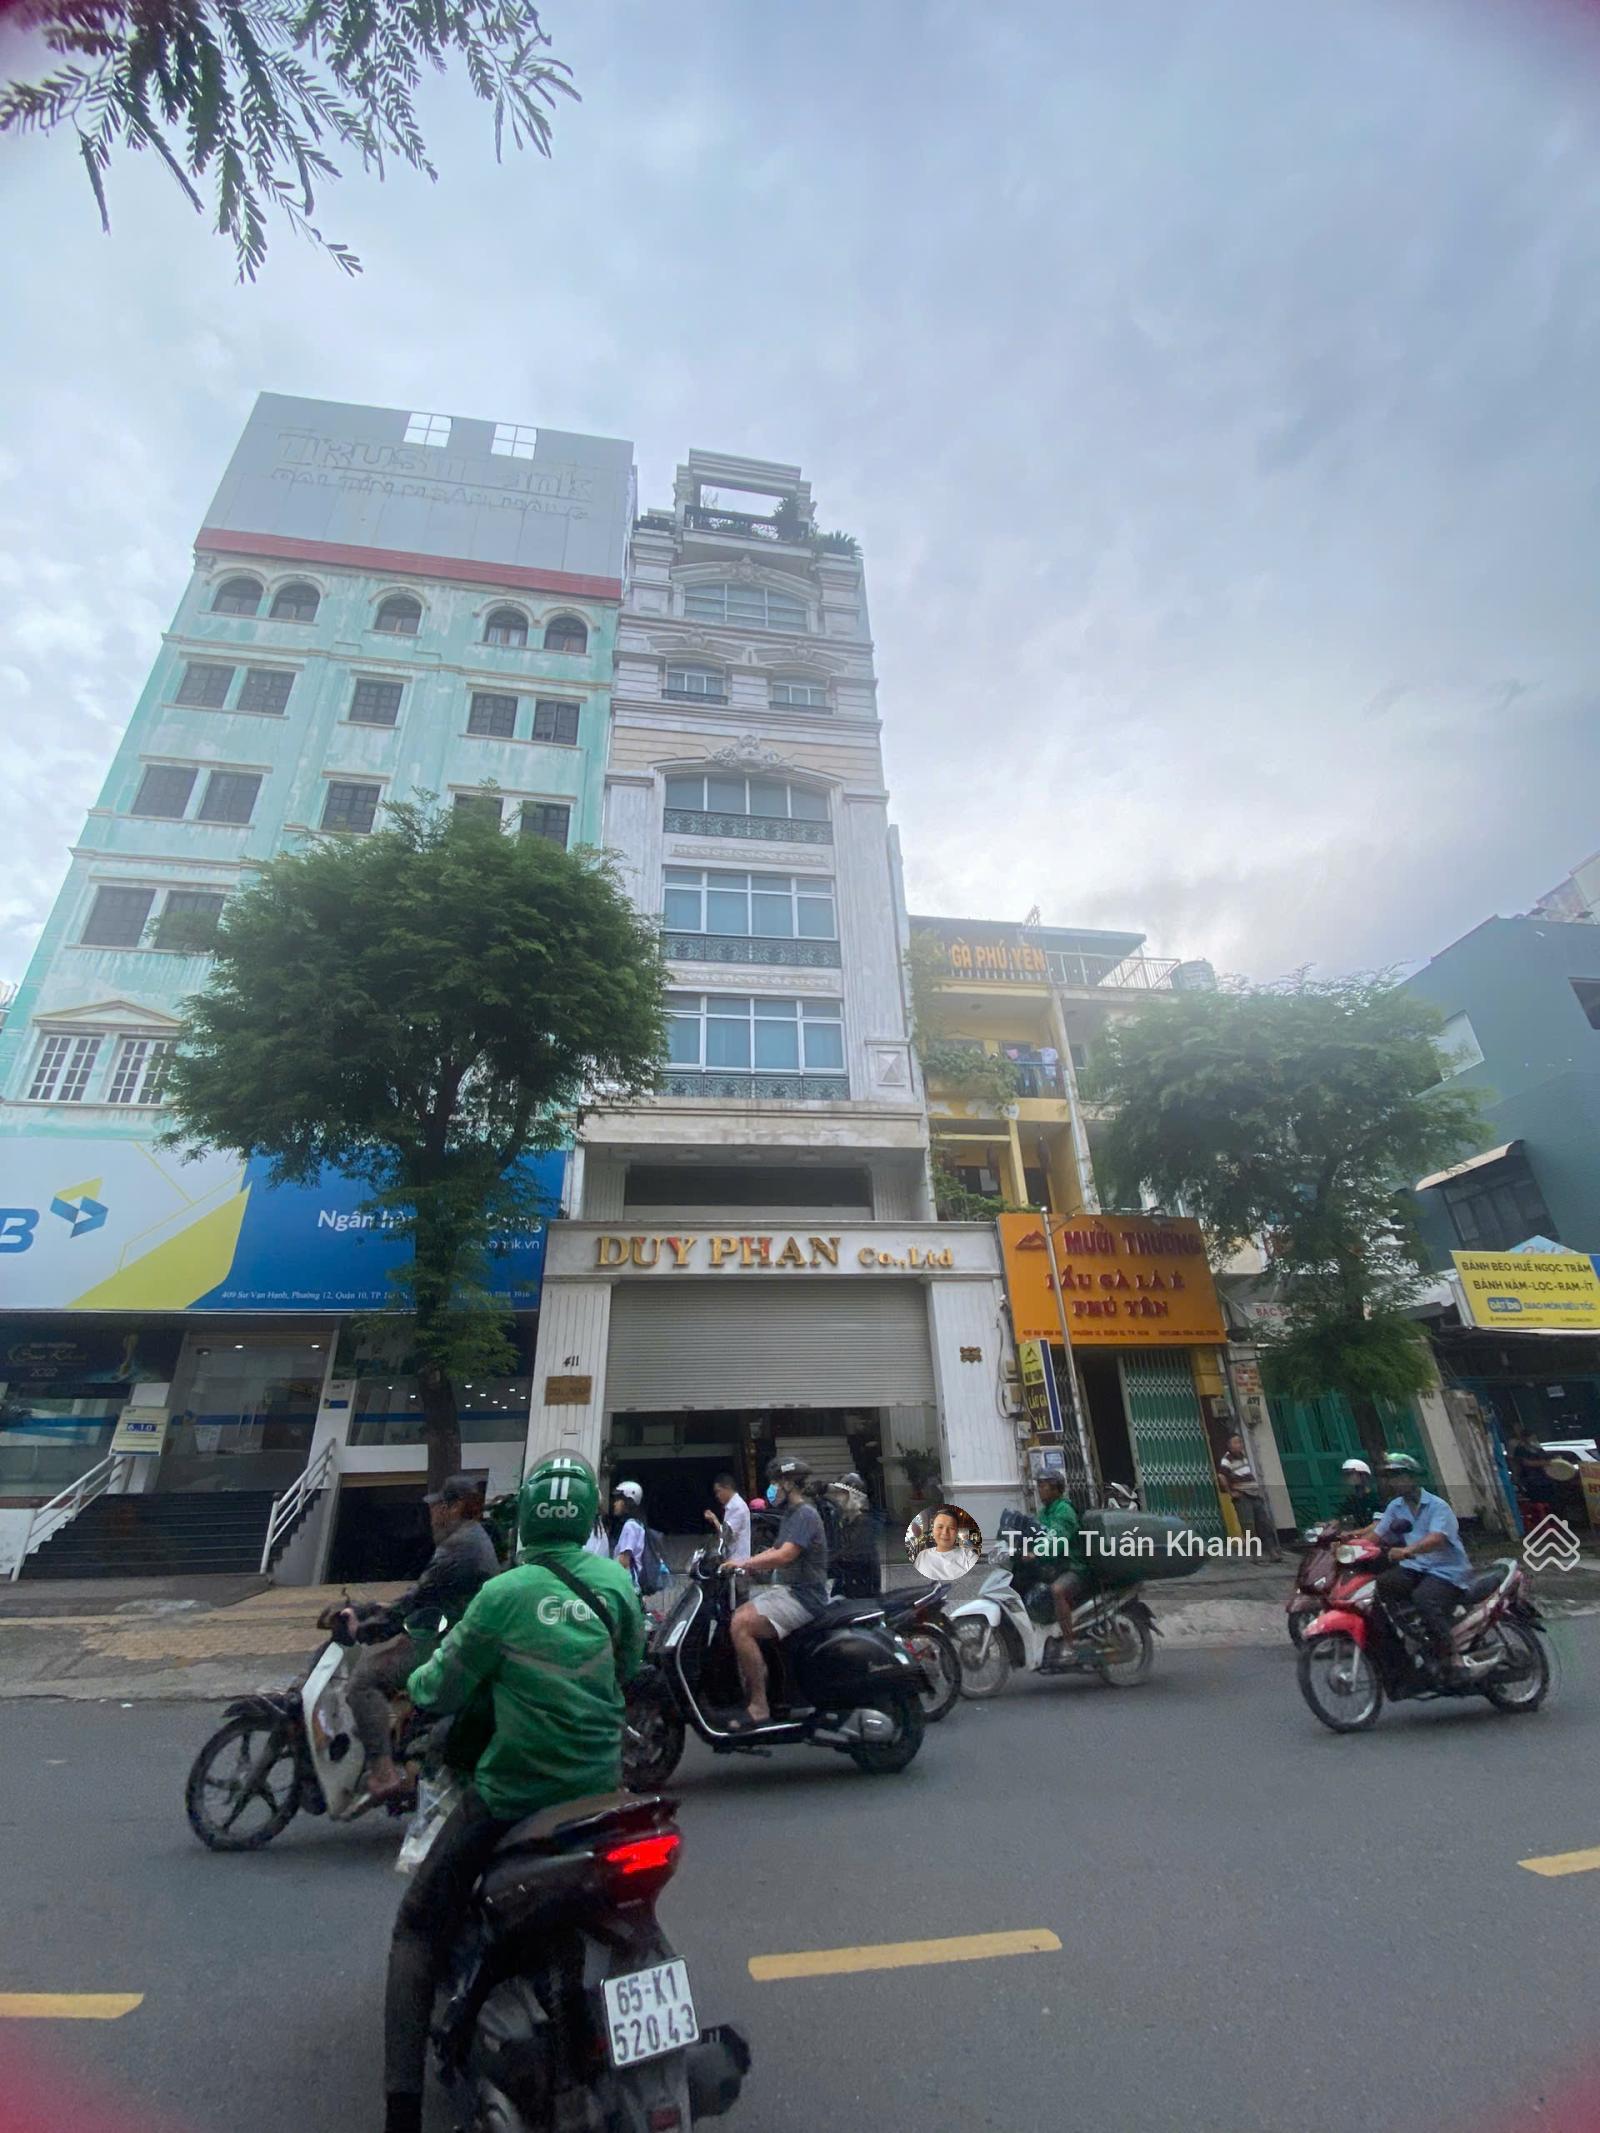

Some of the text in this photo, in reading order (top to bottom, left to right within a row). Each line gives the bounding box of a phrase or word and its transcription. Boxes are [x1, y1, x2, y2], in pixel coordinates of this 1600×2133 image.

[975, 938, 1009, 970] PHÚ
[1011, 943, 1047, 972] YÊN
[598, 1236, 698, 1267] DUY
[709, 1236, 841, 1267] PHAN
[1072, 1296, 1168, 1317] PHÚ YÊN
[562, 1355, 580, 1367] 411
[536, 1502, 579, 1519] Grab
[537, 1589, 608, 1625] Gra
[612, 2003, 696, 2061] 520.43
